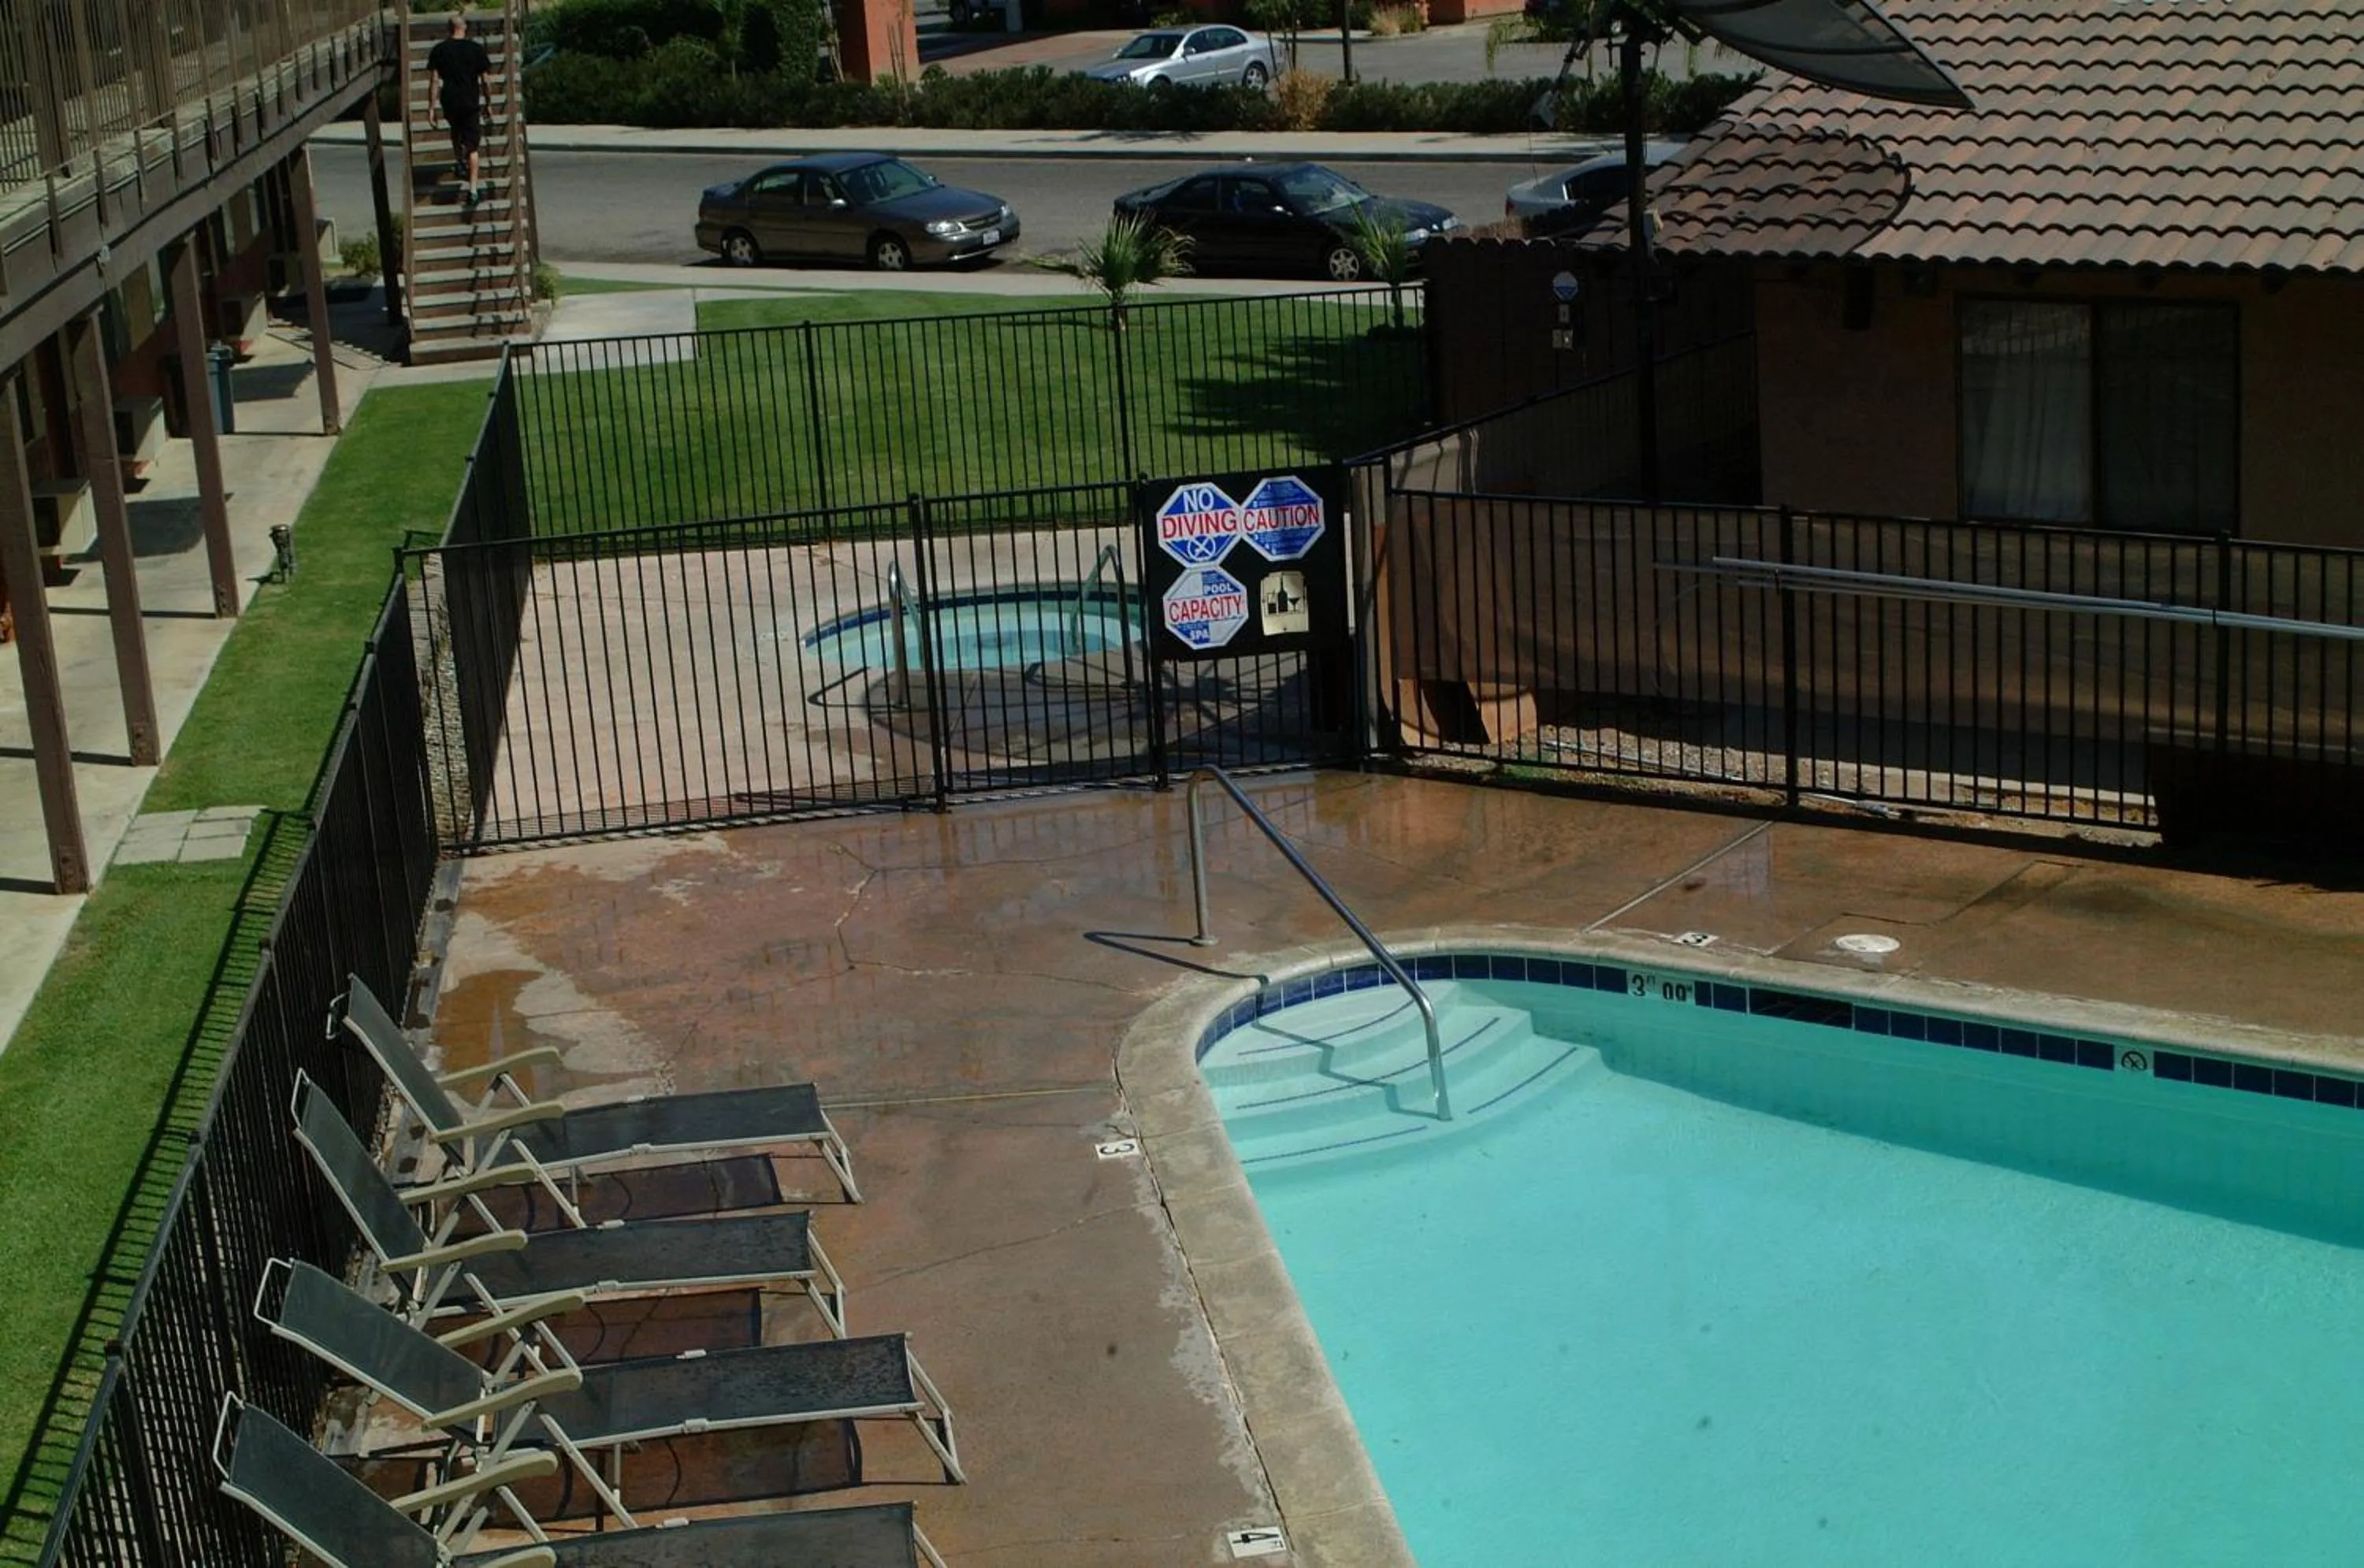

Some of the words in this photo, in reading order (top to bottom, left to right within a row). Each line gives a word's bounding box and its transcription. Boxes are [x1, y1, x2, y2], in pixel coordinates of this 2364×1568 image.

[1183, 489, 1214, 512] NO
[1162, 510, 1236, 539] DIVING
[1243, 505, 1319, 531] CAUTION
[1203, 582, 1233, 595] POOL
[1169, 594, 1241, 622] CAPACITY
